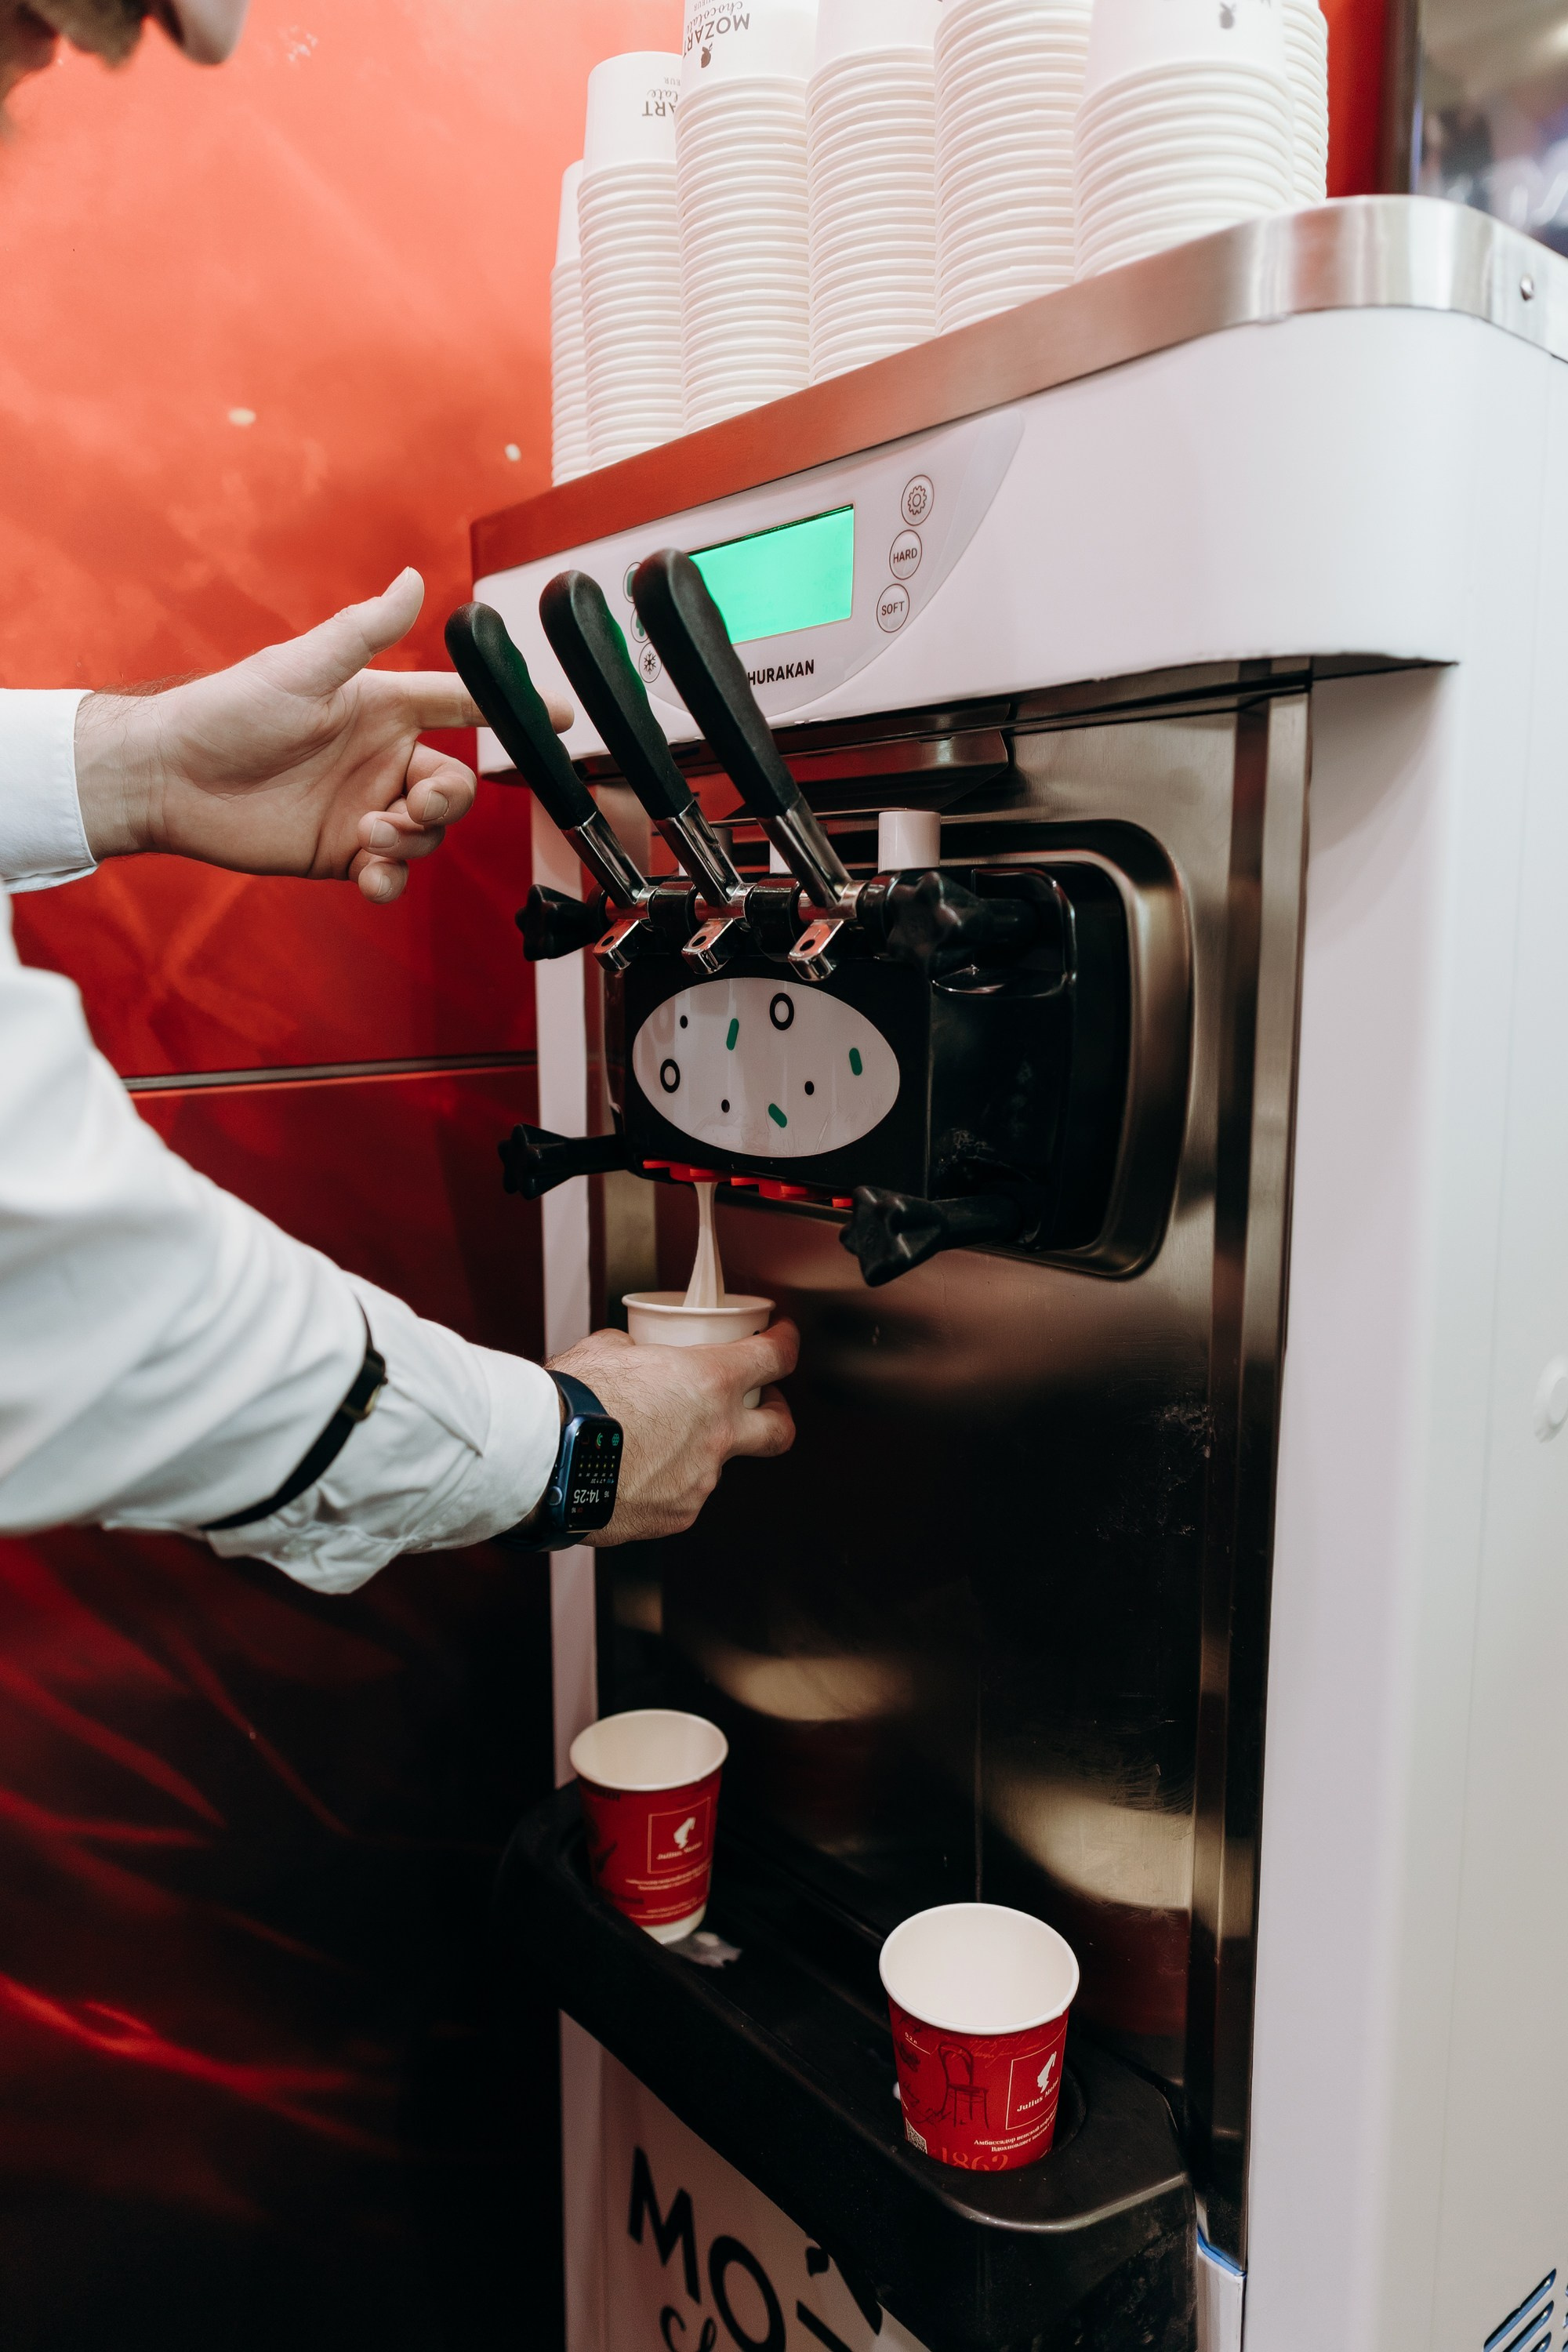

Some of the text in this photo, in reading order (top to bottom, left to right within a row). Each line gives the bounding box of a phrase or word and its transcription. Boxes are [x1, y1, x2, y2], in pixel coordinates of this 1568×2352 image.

[684, 13, 750, 58] MOZART
[893, 547, 918, 564] HARD
[881, 601, 905, 616] SOFT
[748, 659, 815, 685] HURAKAN
[573, 1490, 600, 1504] 14:25
[1016, 2096, 1044, 2112] Julius
[974, 2137, 1016, 2146] Амбассадор
